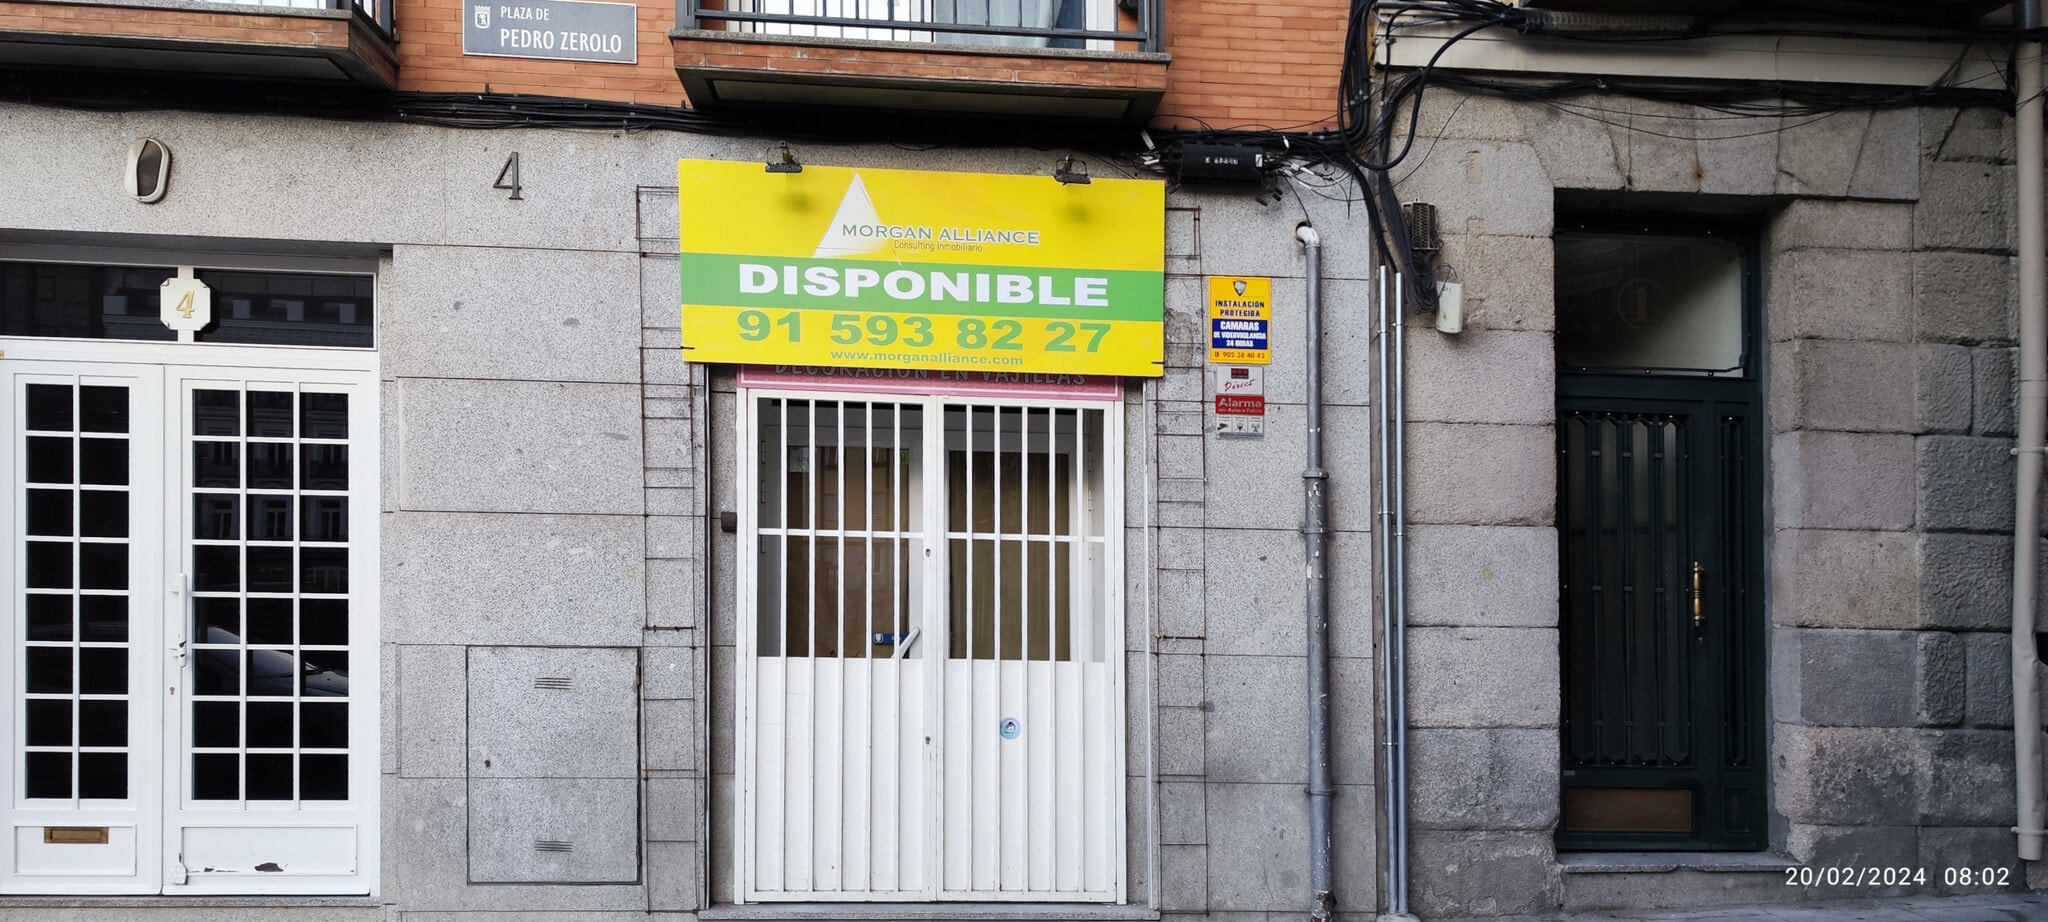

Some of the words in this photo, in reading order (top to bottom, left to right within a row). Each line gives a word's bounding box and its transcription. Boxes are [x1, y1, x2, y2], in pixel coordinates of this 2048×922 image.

[500, 5, 533, 21] PLAZA
[535, 8, 550, 21] DE
[500, 28, 555, 50] PEDRO
[560, 31, 622, 54] ZEROLO
[493, 151, 523, 200] 4
[842, 224, 932, 240] MORGAN
[939, 227, 1040, 244] ALLIANCE
[893, 239, 935, 252] Consulting
[937, 241, 983, 253] Inmobiliario
[739, 263, 1109, 307] DISPONIBLE
[175, 290, 195, 319] 4
[1219, 309, 1260, 317] PROTEGIDA
[737, 310, 800, 343] 91
[829, 313, 935, 348] 593
[956, 318, 1023, 350] 82
[1044, 321, 1112, 353] 27
[1220, 321, 1260, 331] CAMARAS
[830, 350, 1024, 366] www.morganalliance.com
[1218, 397, 1263, 408] Alarma
